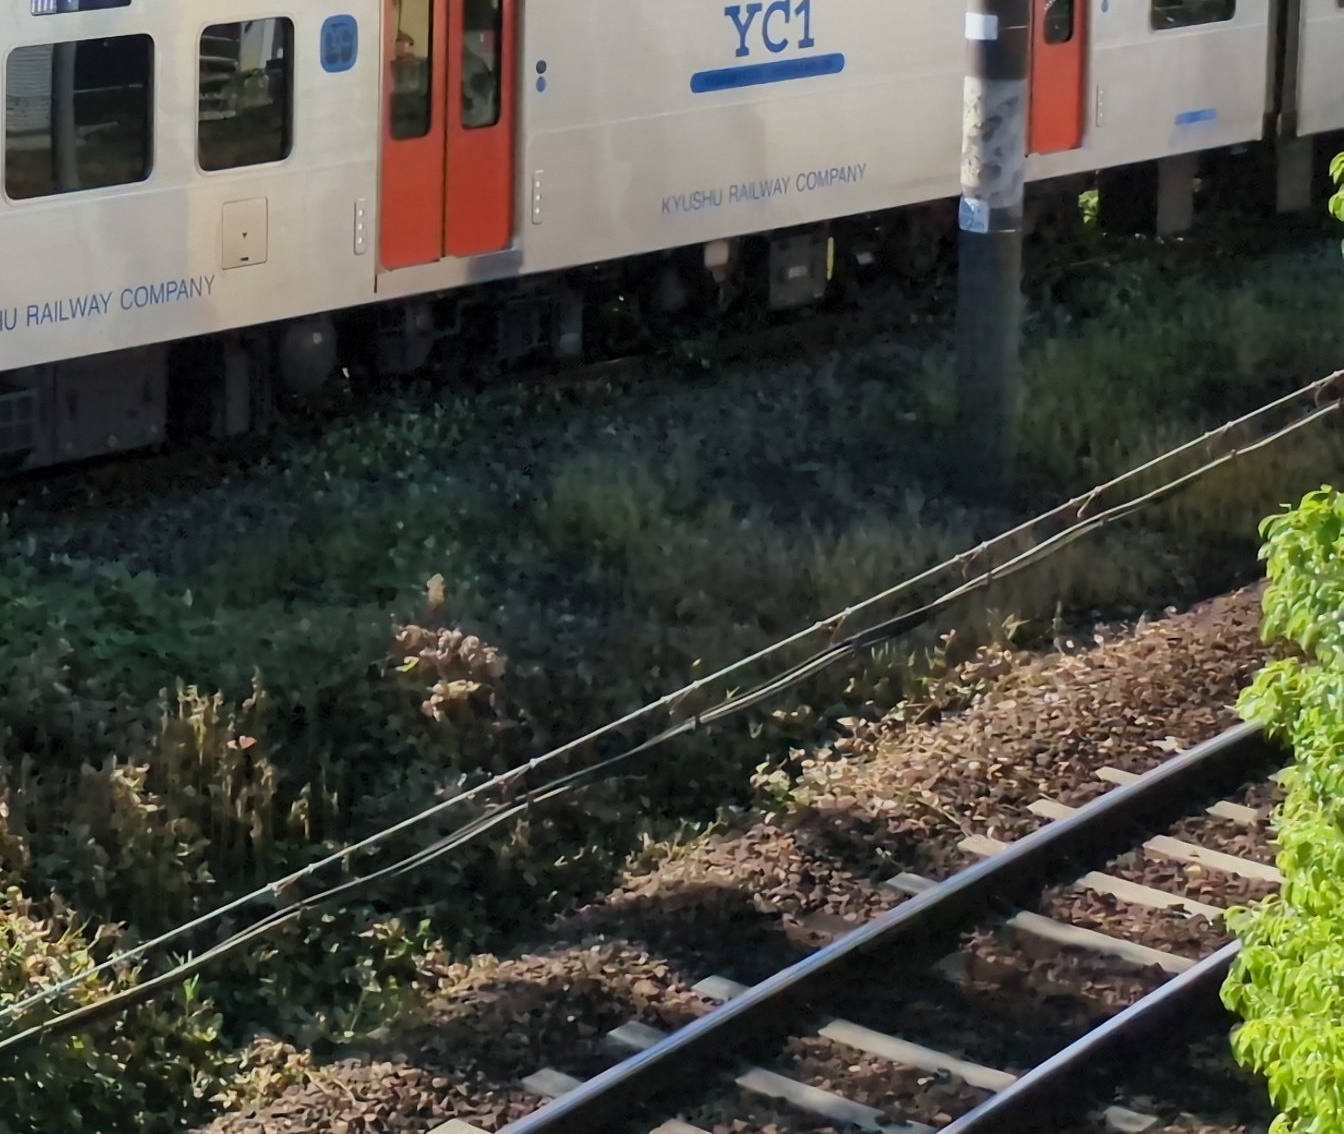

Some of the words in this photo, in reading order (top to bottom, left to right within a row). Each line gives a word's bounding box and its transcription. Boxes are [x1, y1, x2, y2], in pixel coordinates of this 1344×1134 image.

[662, 188, 723, 214] KYUSHU
[729, 176, 790, 203] RAILWAY
[796, 163, 867, 192] COMPANY
[26, 292, 112, 327] RAILWAY
[120, 274, 216, 310] COMPANY
